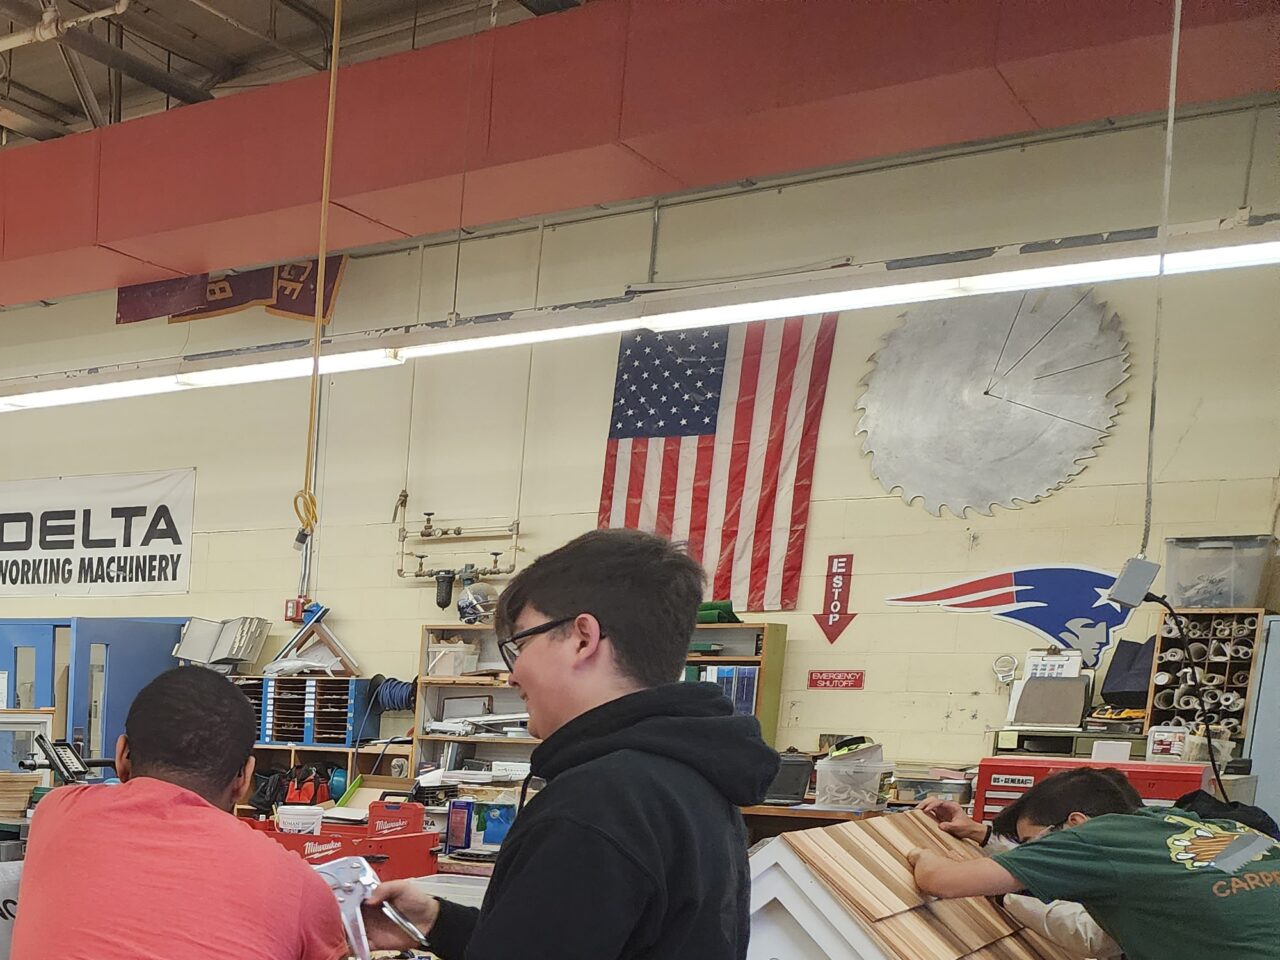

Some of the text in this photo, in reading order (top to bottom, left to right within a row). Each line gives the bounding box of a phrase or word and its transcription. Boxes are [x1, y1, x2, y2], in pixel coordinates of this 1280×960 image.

[77, 553, 182, 584] MACHINERY
[828, 575, 843, 625] STOP
[812, 672, 862, 681] EMERGENCY
[816, 680, 855, 688] SHUTOFF
[375, 819, 408, 831] Milwaukee
[303, 840, 342, 855] Milwaukee
